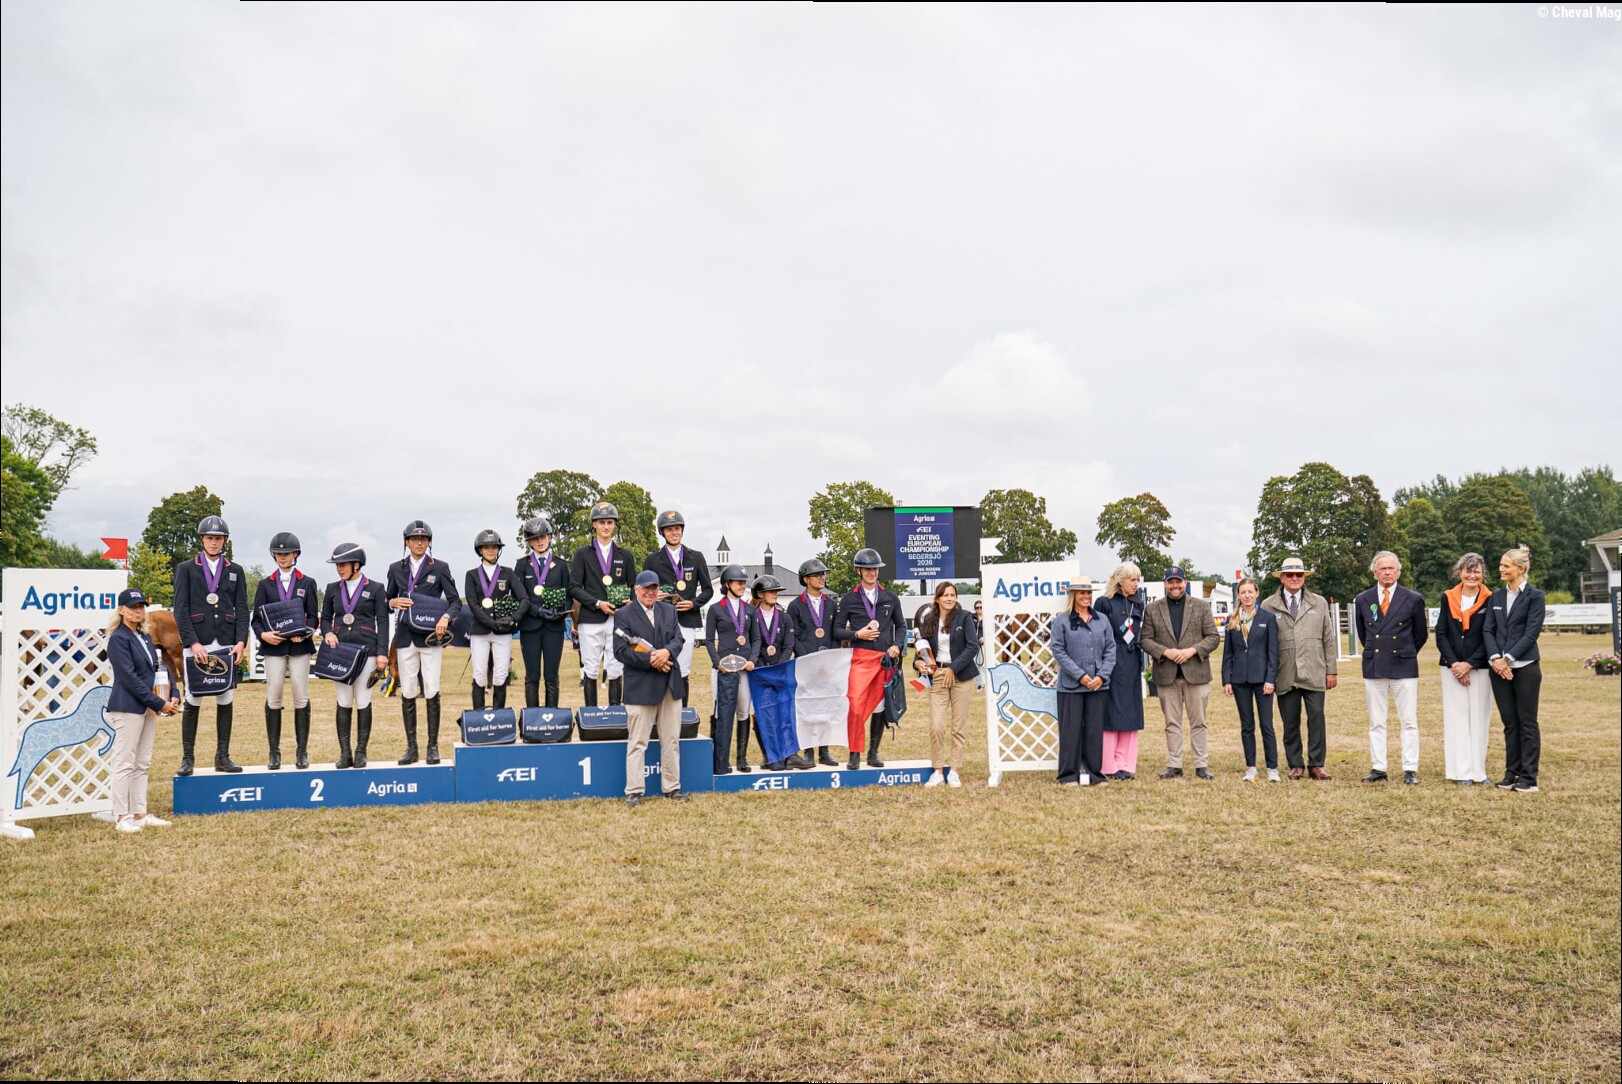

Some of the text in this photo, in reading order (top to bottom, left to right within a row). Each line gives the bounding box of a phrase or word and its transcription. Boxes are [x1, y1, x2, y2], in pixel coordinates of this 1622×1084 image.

[913, 515, 931, 523] Agria
[908, 552, 942, 560] SEGERSJÖ
[993, 576, 1054, 603] Agria
[21, 585, 96, 616] Agria
[415, 614, 431, 622] Agria
[328, 662, 344, 671] Agria
[203, 676, 221, 685] Agria
[496, 767, 537, 782] FEI
[577, 756, 592, 786] 1
[752, 771, 911, 790] FEI 3 Agria
[218, 778, 405, 803] FEI 2 Agria
